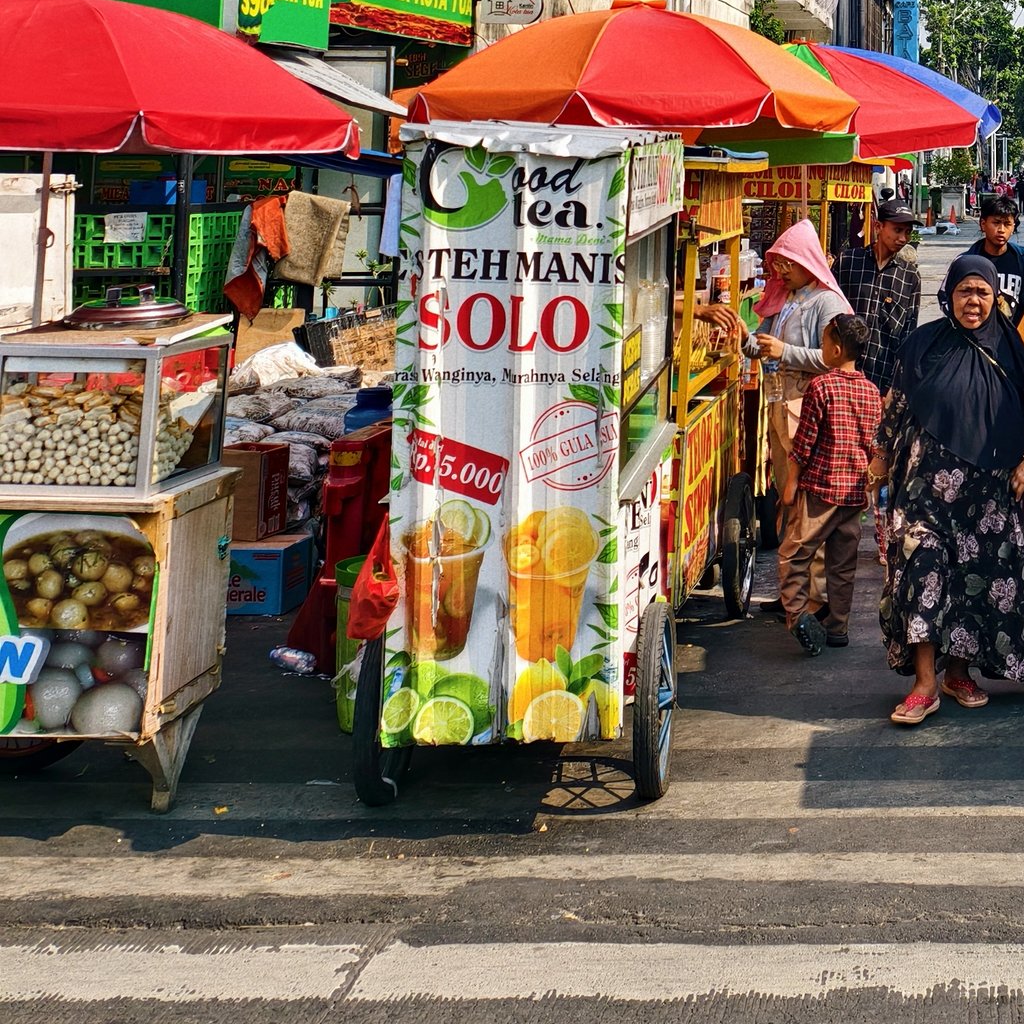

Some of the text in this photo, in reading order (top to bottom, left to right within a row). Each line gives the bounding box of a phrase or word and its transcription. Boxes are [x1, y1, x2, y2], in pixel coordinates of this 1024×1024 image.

[743, 180, 812, 198] CILOR
[834, 182, 866, 199] CILOR
[418, 292, 591, 353] SOLO
[421, 367, 497, 385] Wanginya,
[502, 367, 566, 386] Murahnya
[527, 423, 619, 471] 100% GULA SLI
[439, 454, 504, 494] 5.000
[228, 575, 241, 588] e
